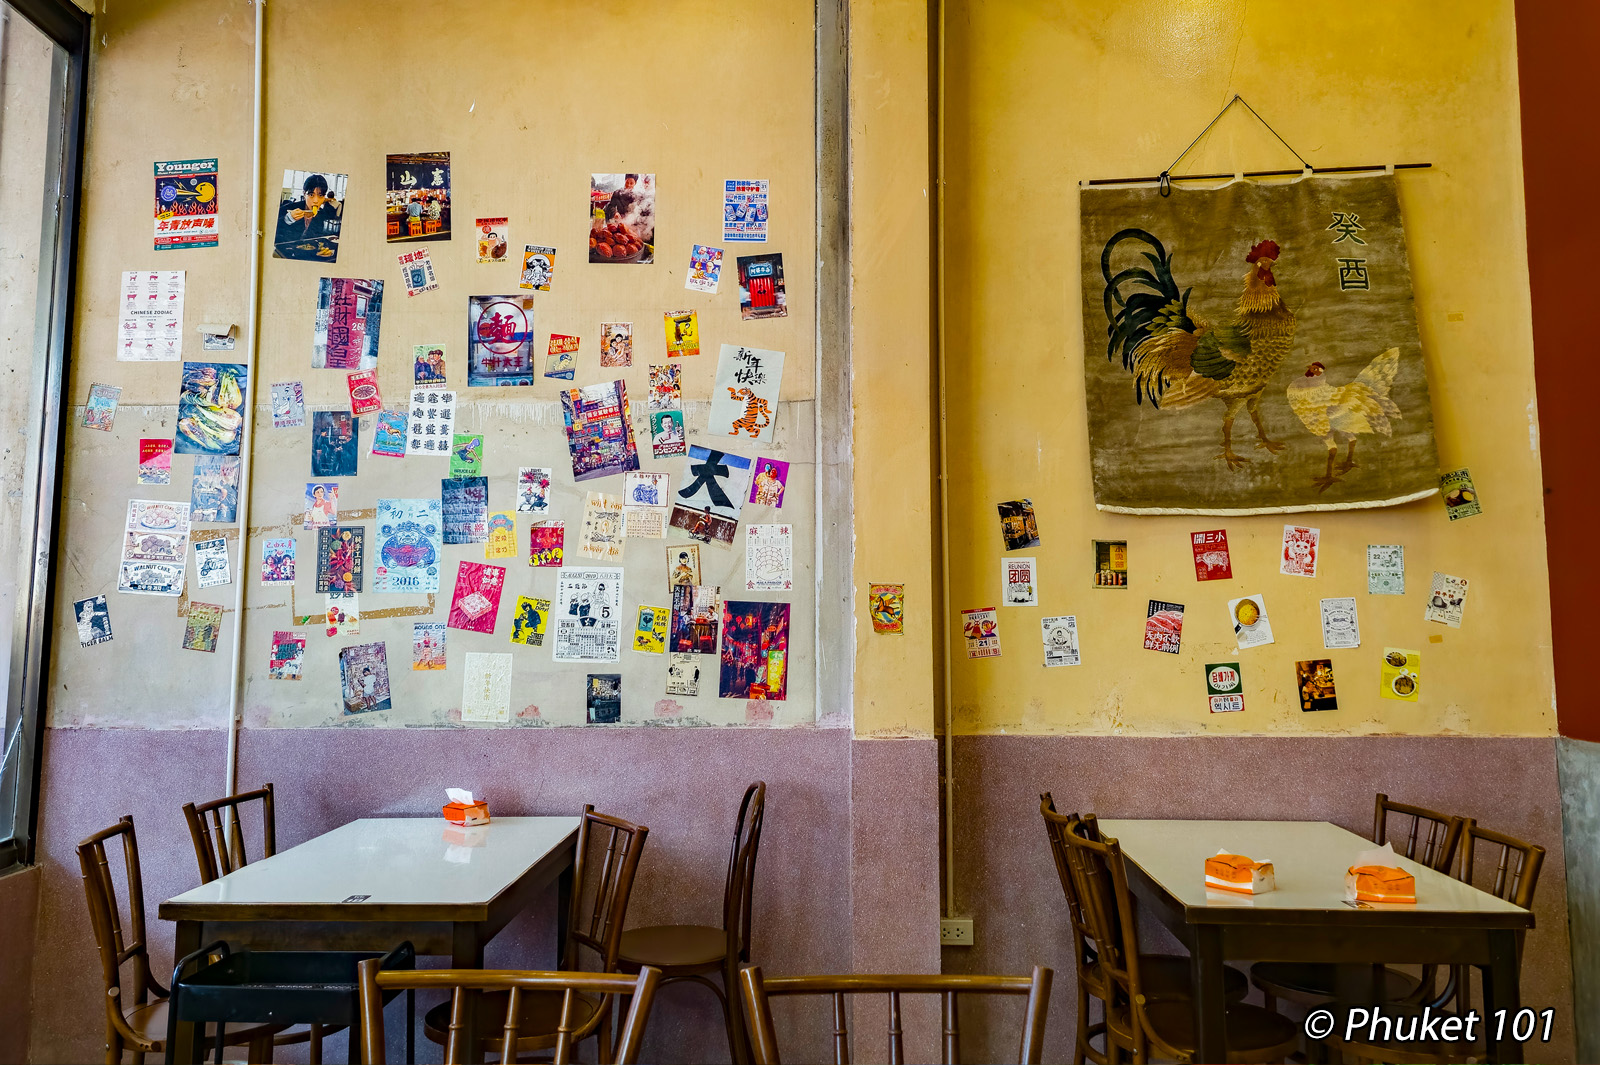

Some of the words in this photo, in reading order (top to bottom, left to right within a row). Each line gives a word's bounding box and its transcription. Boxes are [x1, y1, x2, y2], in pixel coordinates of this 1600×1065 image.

[156, 162, 215, 171] Younger
[1325, 212, 1370, 291] 癸酉
[678, 450, 736, 509] 大
[157, 565, 171, 573] CAKE
[392, 576, 420, 586] 2016
[1009, 570, 1031, 583] 团圆
[601, 606, 610, 618] 5
[81, 639, 98, 648] TIGER
[99, 635, 114, 644] BALM
